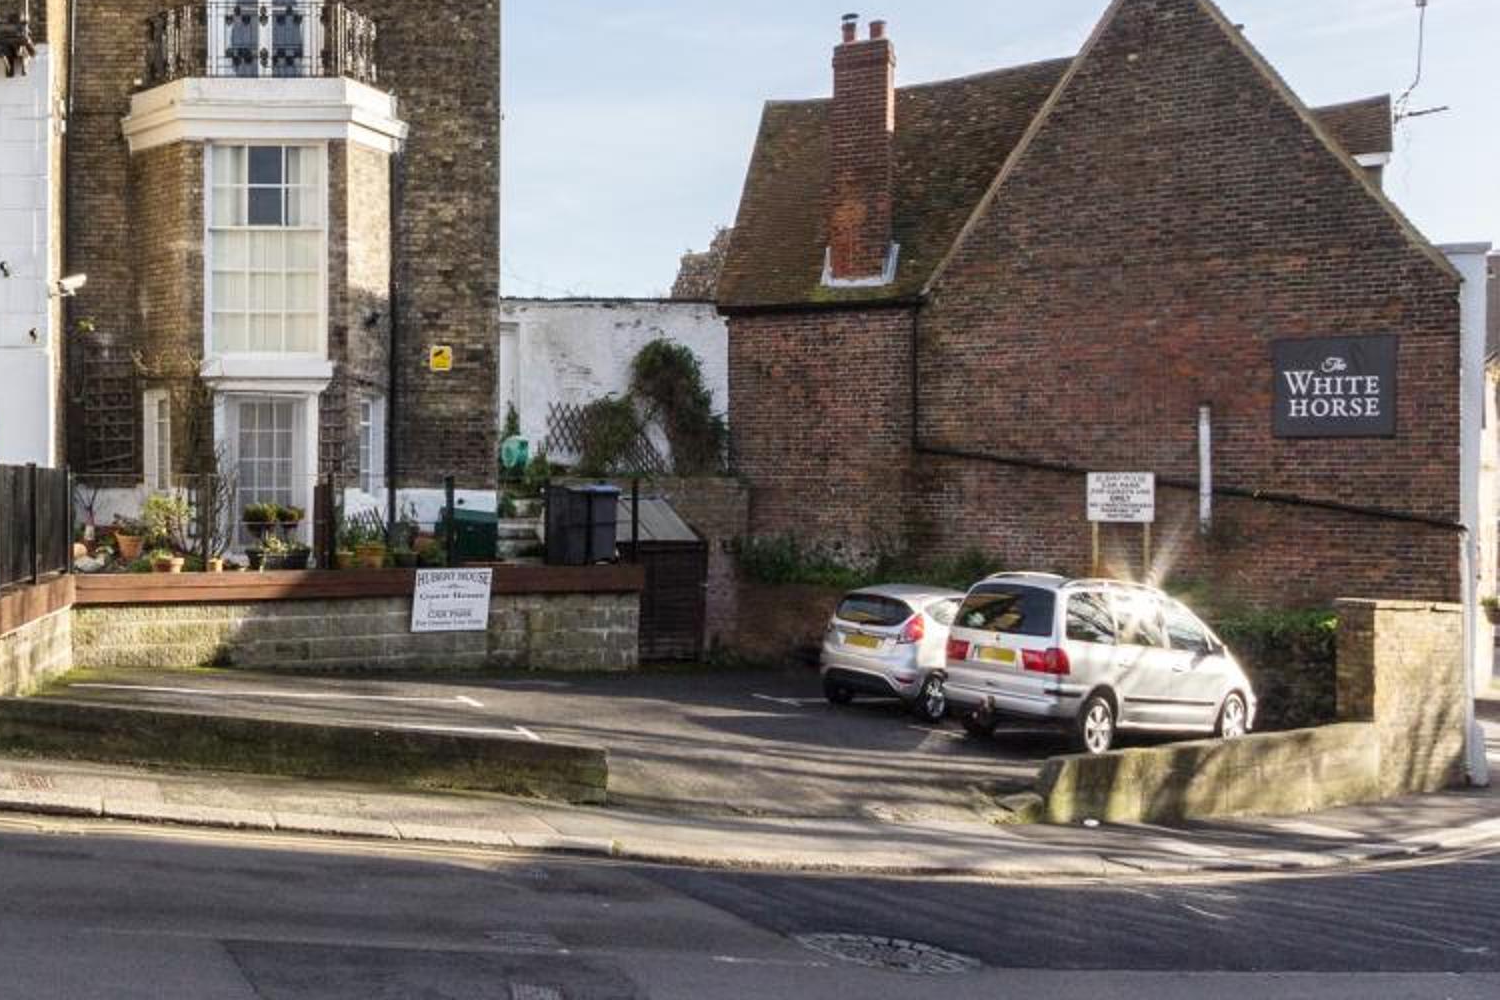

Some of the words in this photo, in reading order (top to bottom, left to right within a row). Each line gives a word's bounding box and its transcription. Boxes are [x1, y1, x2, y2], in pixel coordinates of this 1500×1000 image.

[1321, 357, 1347, 372] The
[1284, 370, 1380, 395] WHITE
[1288, 398, 1380, 417] HORSE
[418, 572, 455, 586] HUBERT
